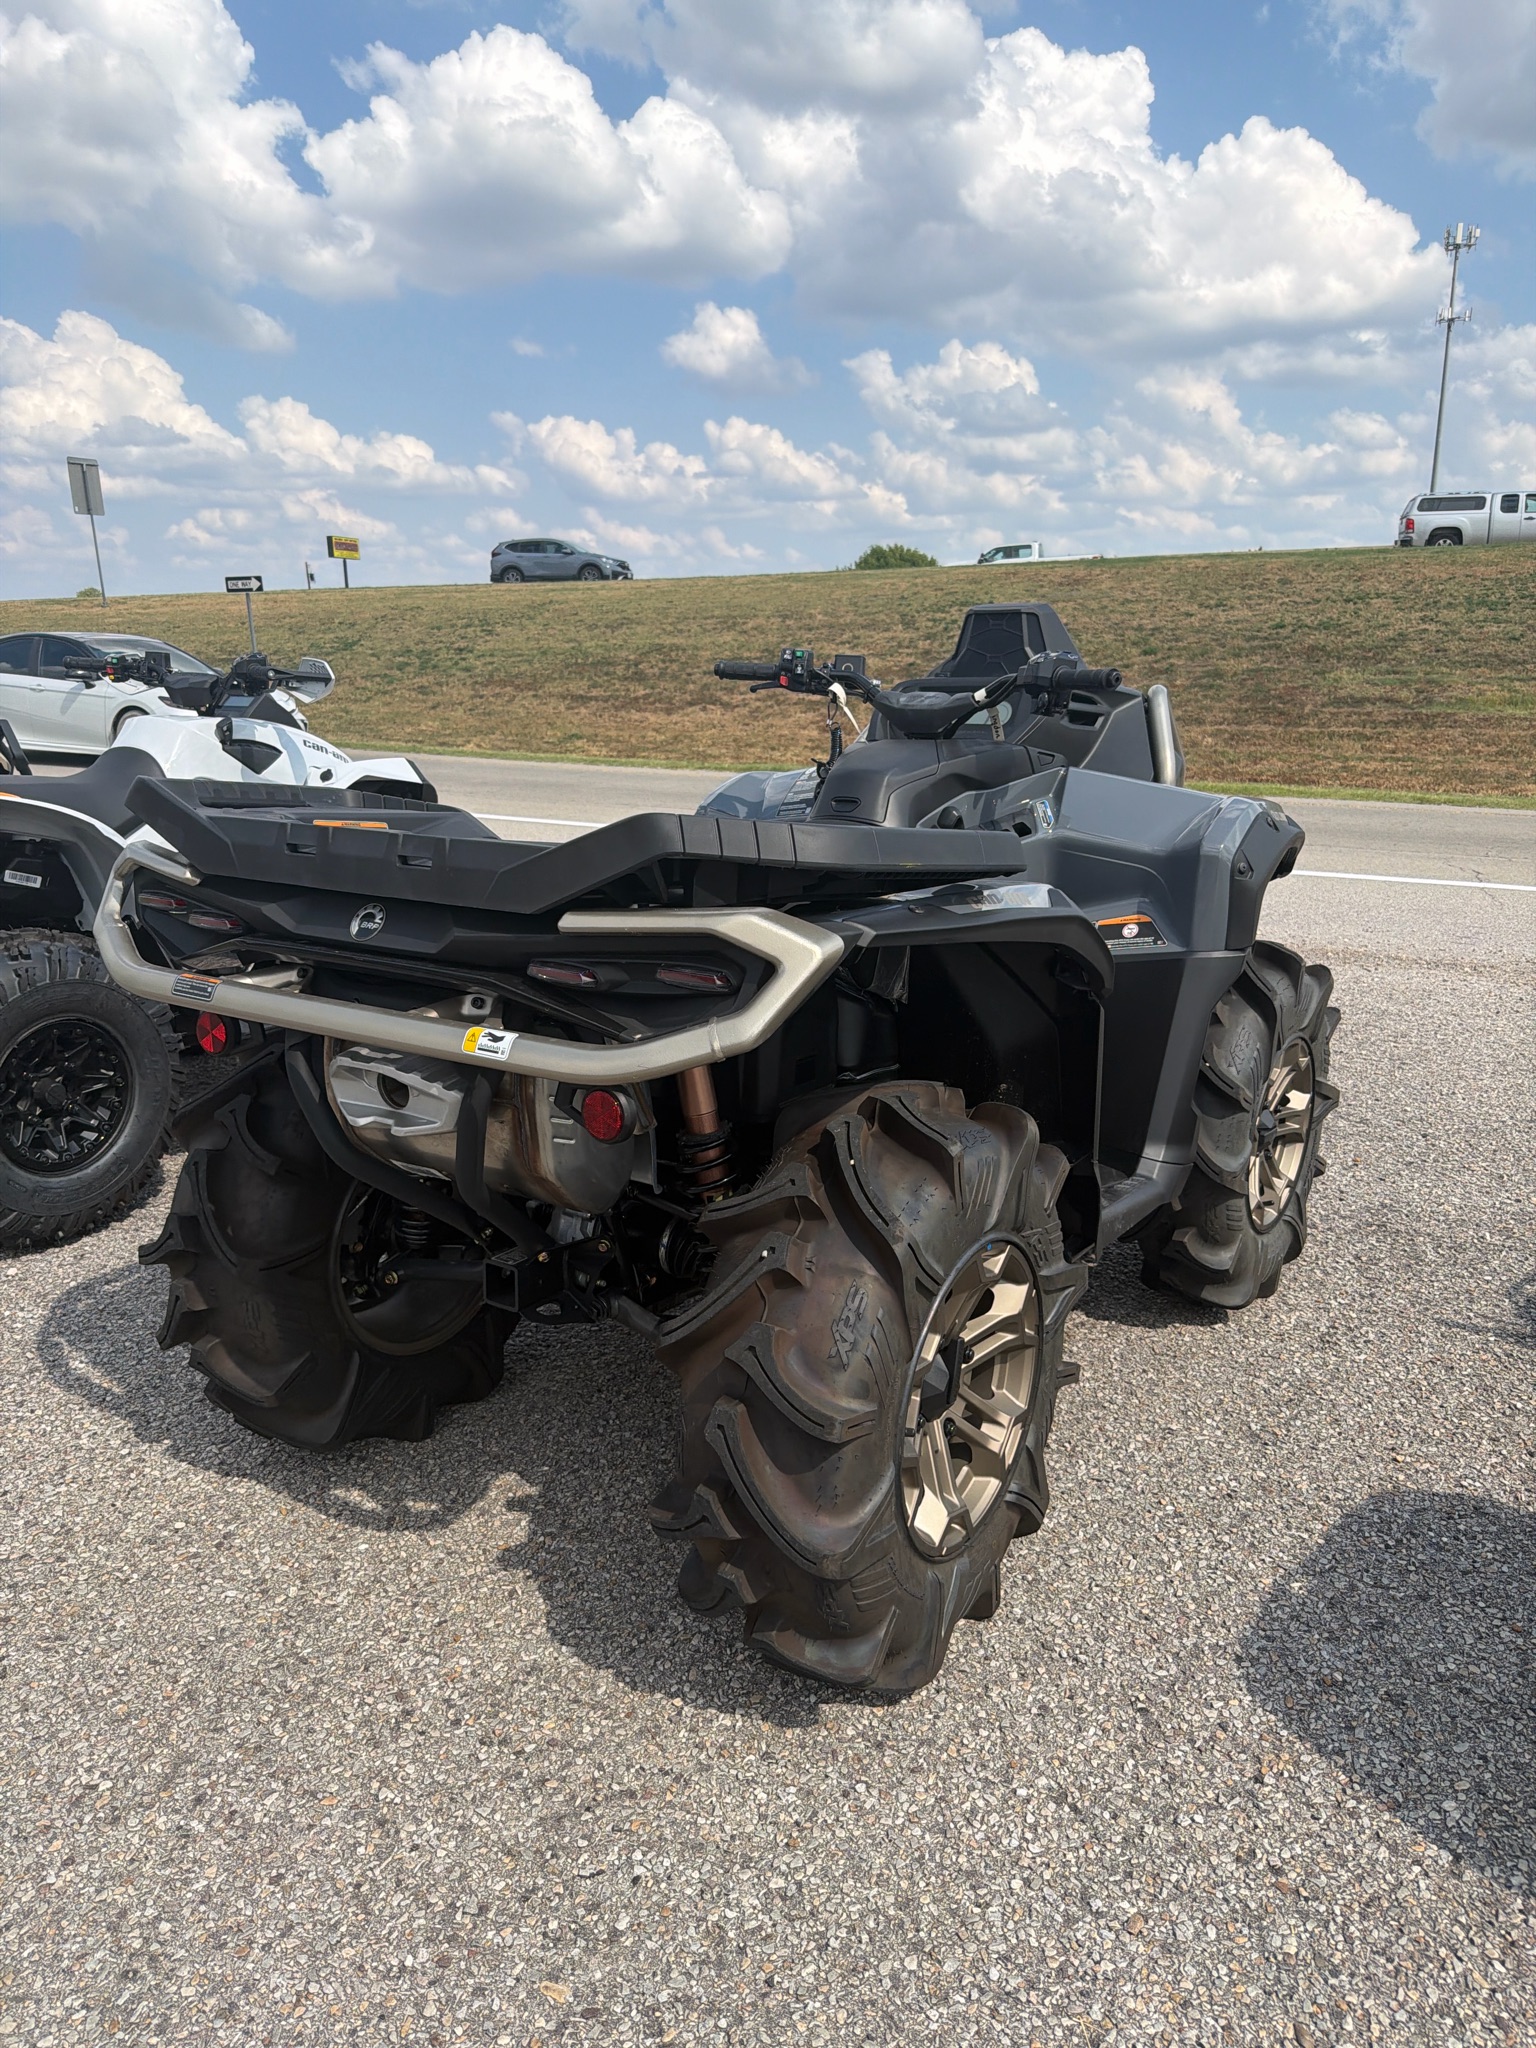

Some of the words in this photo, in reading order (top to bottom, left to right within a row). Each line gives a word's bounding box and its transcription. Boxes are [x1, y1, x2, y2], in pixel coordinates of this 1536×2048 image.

[230, 581, 240, 589] ONE
[360, 921, 380, 930] BRP
[827, 1278, 869, 1372] XPS
